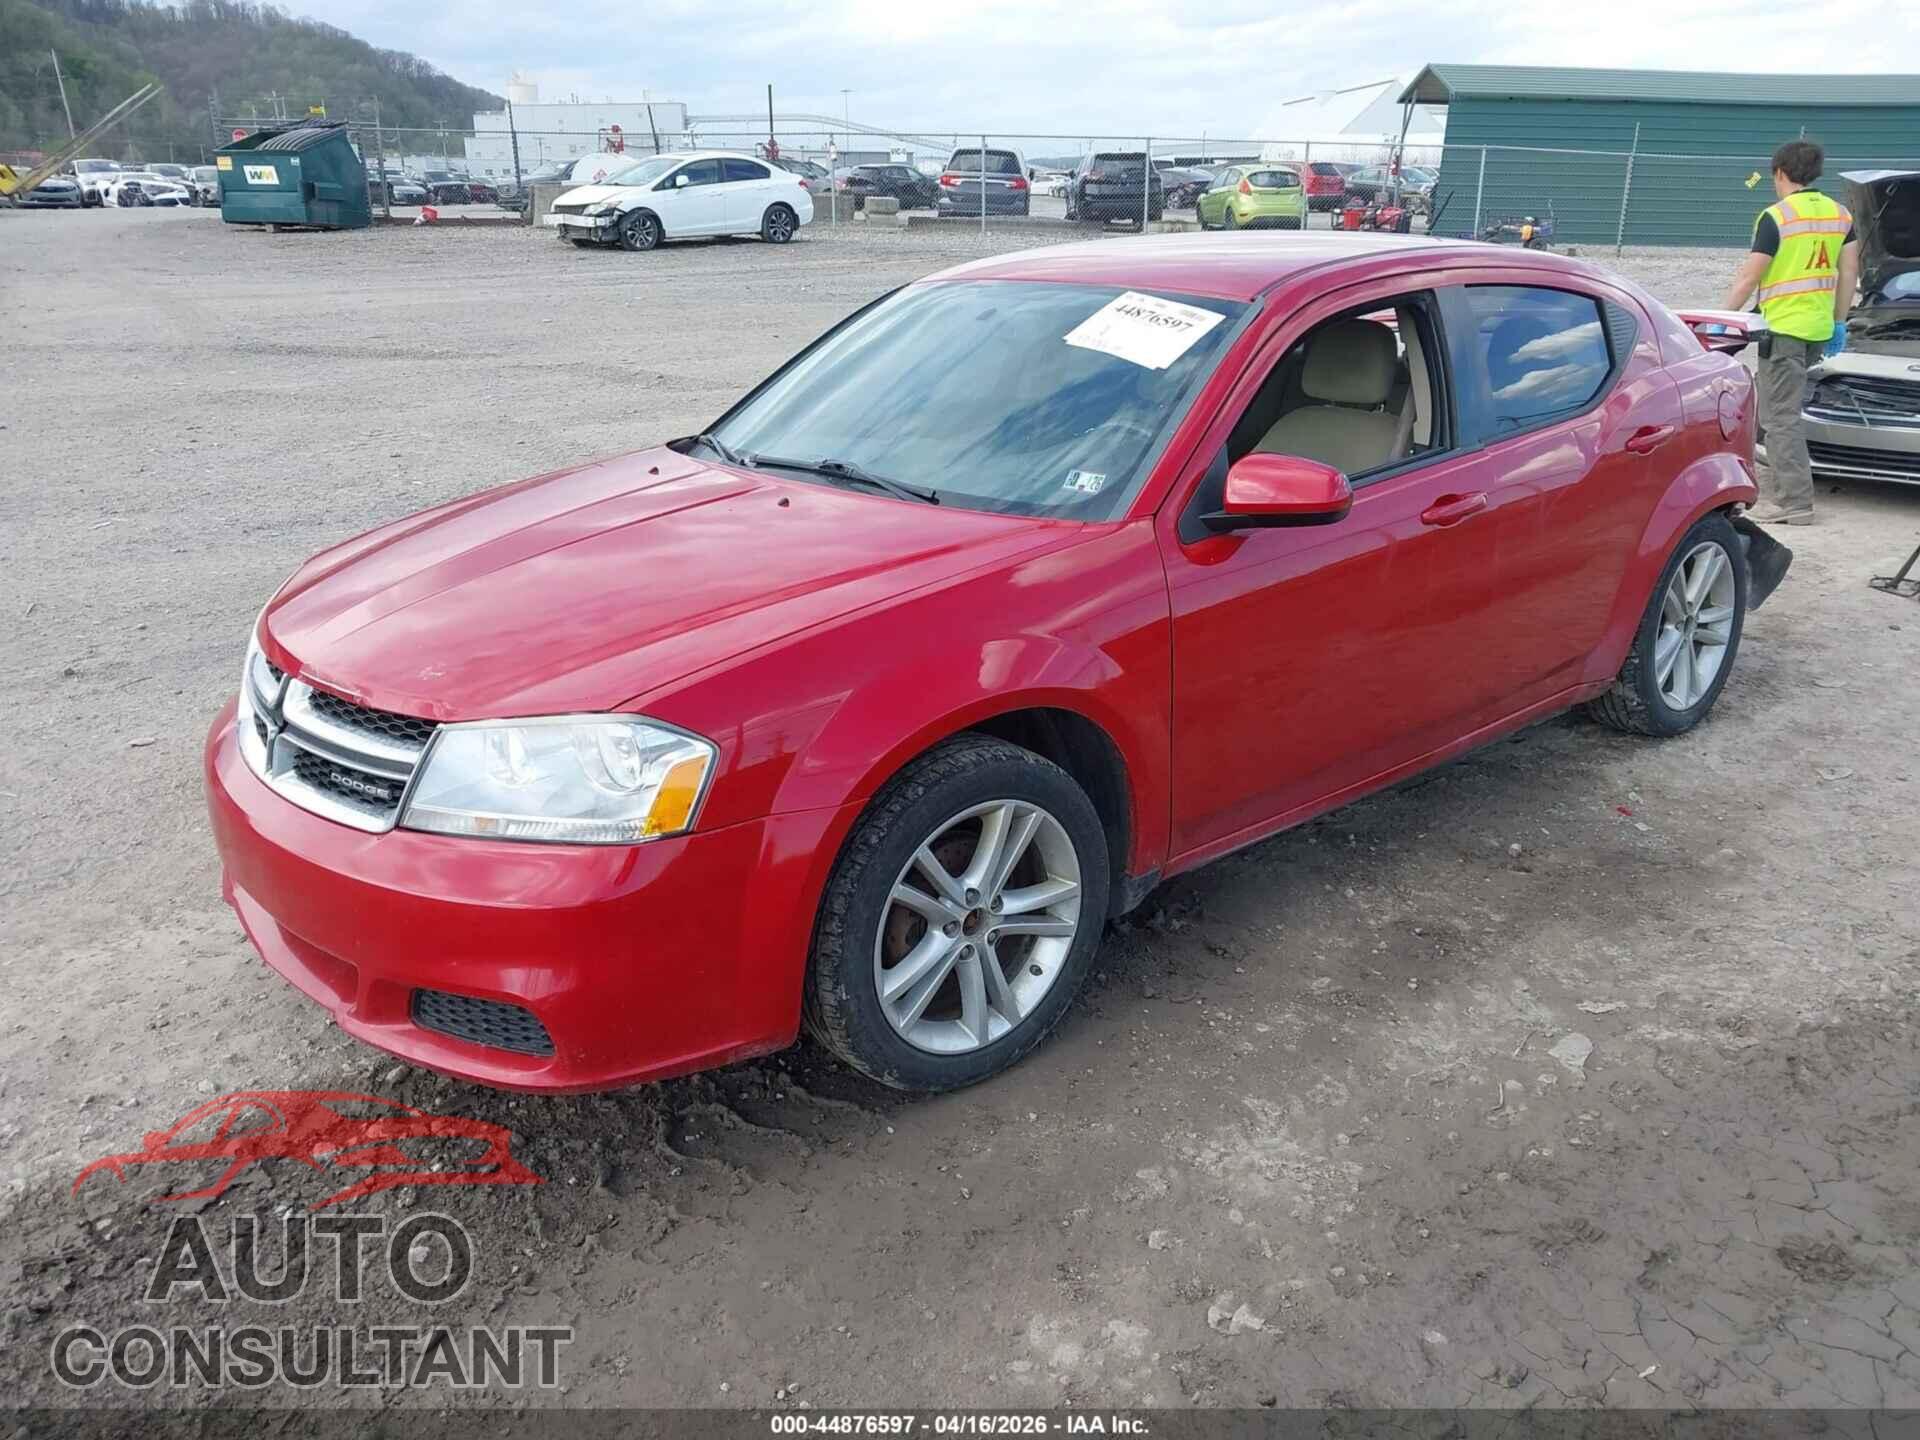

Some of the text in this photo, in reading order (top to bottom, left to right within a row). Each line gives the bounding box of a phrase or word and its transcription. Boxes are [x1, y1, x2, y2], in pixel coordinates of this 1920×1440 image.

[249, 170, 274, 180] WM
[1115, 304, 1193, 332] 44876597
[331, 773, 390, 798] DODGE
